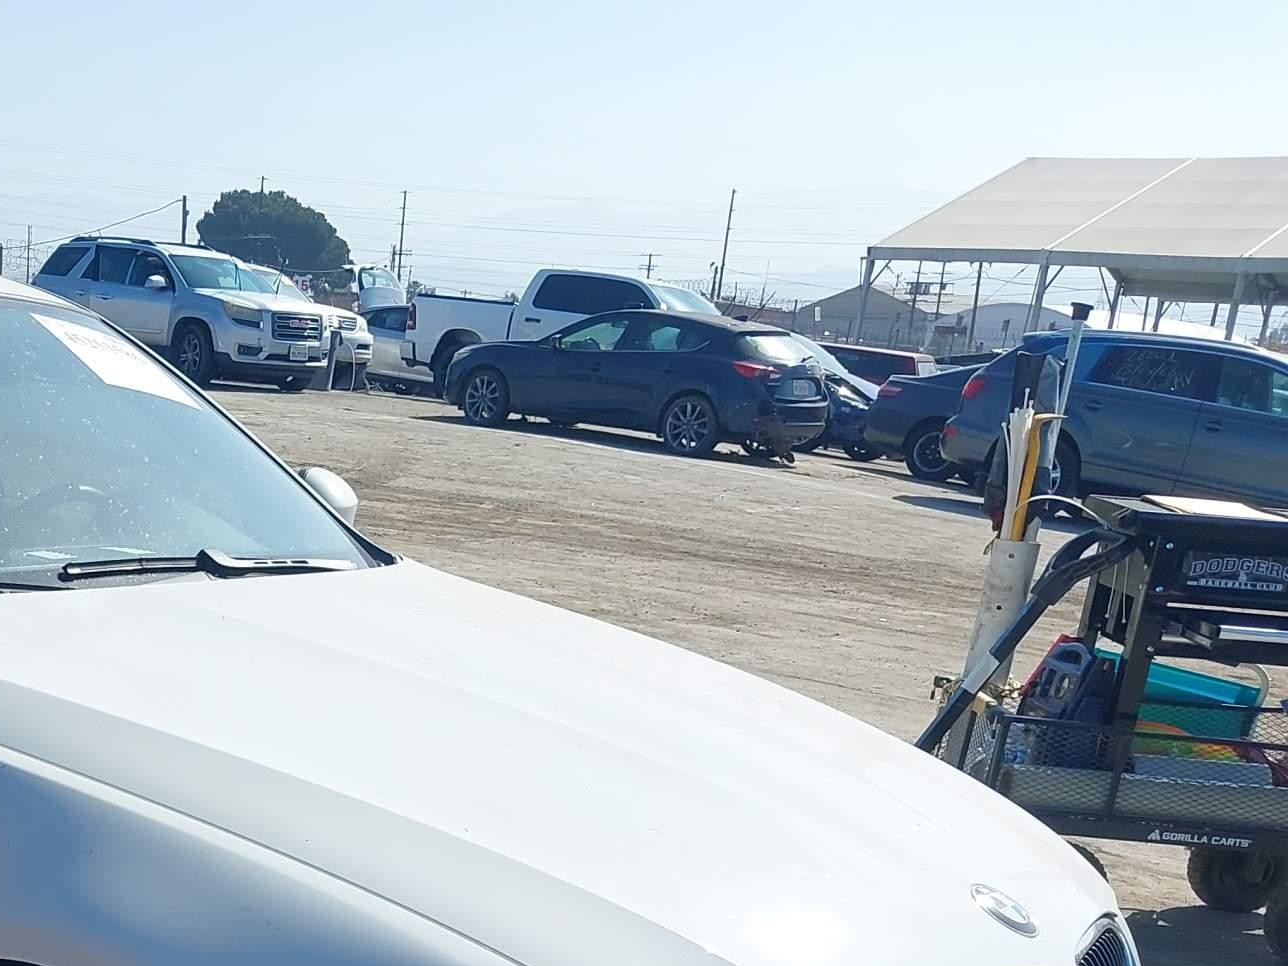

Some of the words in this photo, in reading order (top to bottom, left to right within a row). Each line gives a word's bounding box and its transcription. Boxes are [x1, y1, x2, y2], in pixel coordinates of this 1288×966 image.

[1198, 579, 1253, 590] BASEBALL
[1256, 582, 1283, 592] CLUB
[1162, 832, 1208, 844] GORILLA
[1211, 836, 1249, 848] CARTS
